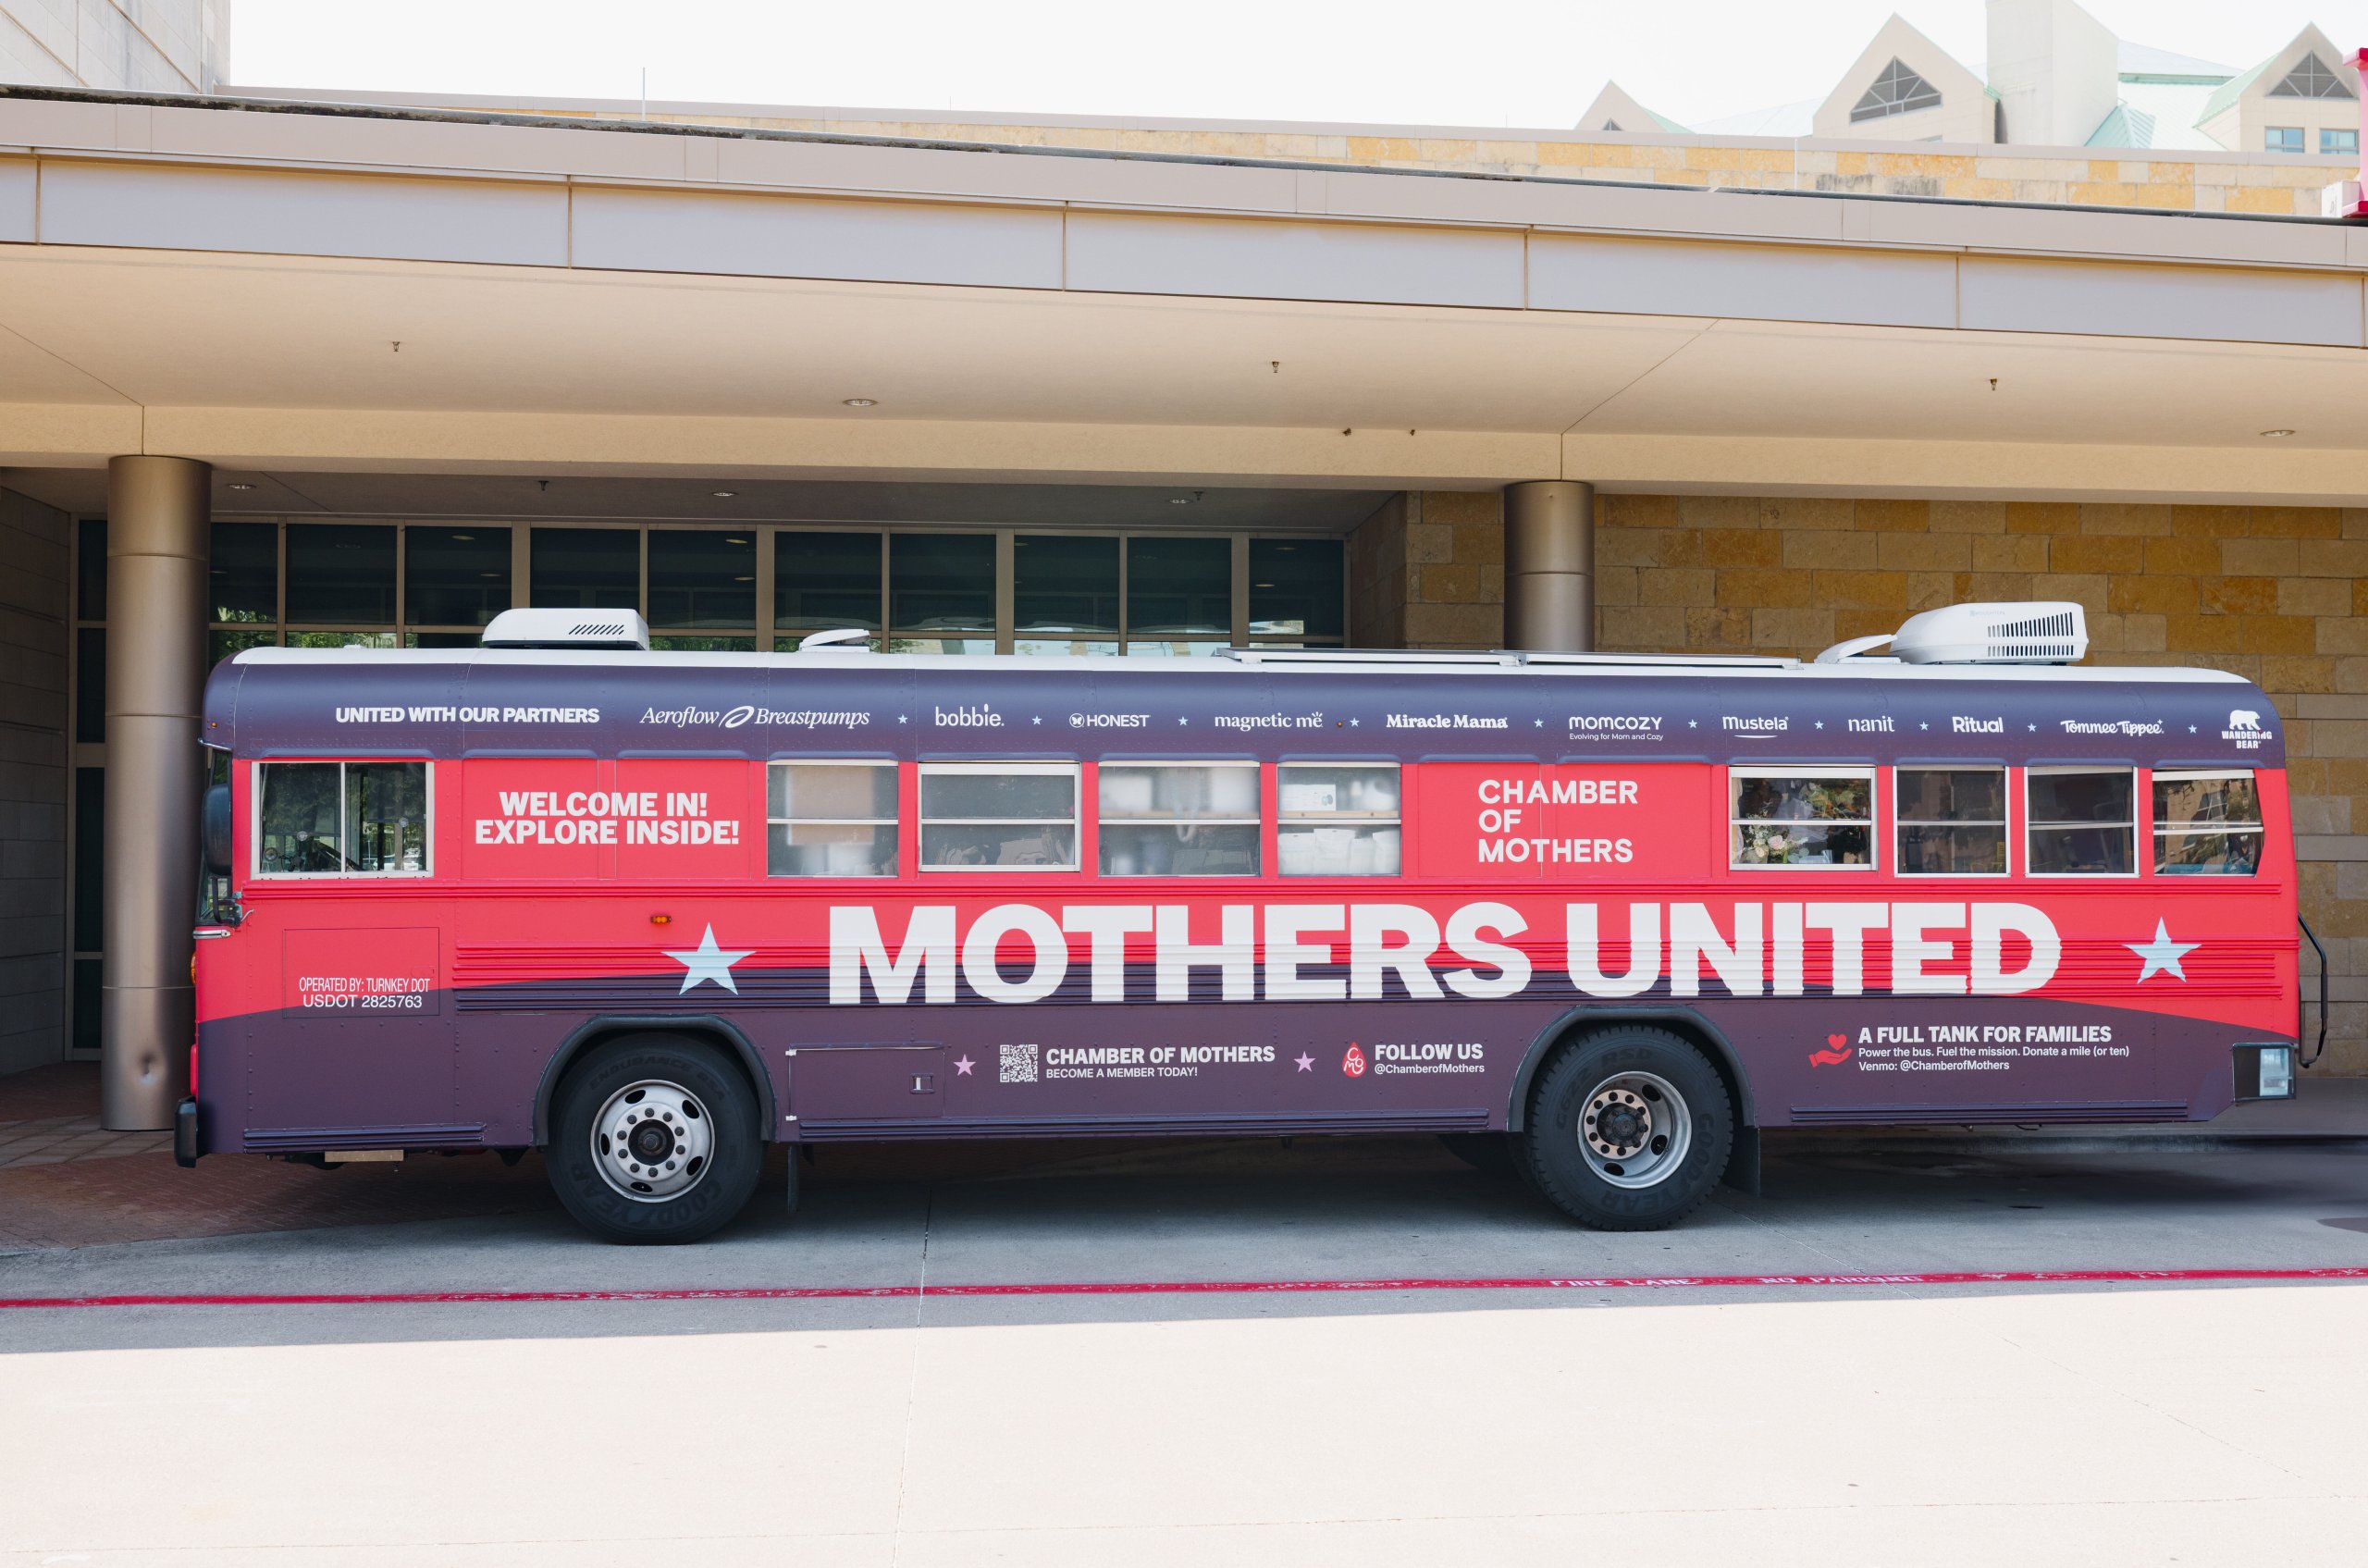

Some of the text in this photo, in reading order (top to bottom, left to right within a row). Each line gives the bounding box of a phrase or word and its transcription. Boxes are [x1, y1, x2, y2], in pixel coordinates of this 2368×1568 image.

[335, 706, 600, 723] UNITED WITH OUR PARTNERS
[638, 706, 870, 730] Aeroflow Breastpumps
[935, 703, 1005, 727] bobbie.
[1086, 714, 1151, 728] HONEST
[1215, 711, 1292, 732] magnetic
[1386, 713, 1509, 729] Miracle Mama
[1721, 716, 1789, 731] Mustela
[1847, 715, 1895, 733] nanit
[1952, 715, 2004, 734] Ritual
[2059, 719, 2162, 737] Tommee Tippee
[1569, 733, 1599, 742] Evolving
[1646, 733, 1664, 742] Cozy
[2221, 730, 2273, 742] WANDERING
[2236, 739, 2259, 749] BEAR
[1477, 779, 1638, 805] CHAMBER
[499, 791, 708, 817] WELCOME IN!
[1478, 809, 1523, 833] OF
[475, 819, 740, 846] EXPLORE INSIDE!
[1478, 837, 1634, 866] MOTHERS
[829, 901, 2063, 1005] MOTHERS UNITED
[299, 976, 431, 993] OPERATED BY: TURNKEY DOT
[302, 994, 423, 1008] USDOT 2825763
[1857, 1025, 2112, 1044] A FULL TANK FOR FAMILIES
[1045, 1045, 1276, 1066] CHAMBER OF MOTHERS
[1375, 1043, 1484, 1061] FOLLOW US
[1858, 1045, 2130, 1057] Power the bus. Fuel the mission. Donate a mile (or ten)
[1045, 1066, 1198, 1079] BECOME A MEMBER TODAY!
[1374, 1063, 1486, 1075] @ChamberofMothers
[1858, 1059, 2010, 1072] Venmo: @ChamberofMothers
[1622, 1278, 1701, 1287] LANE
[1809, 1275, 1925, 1284] PARKING
